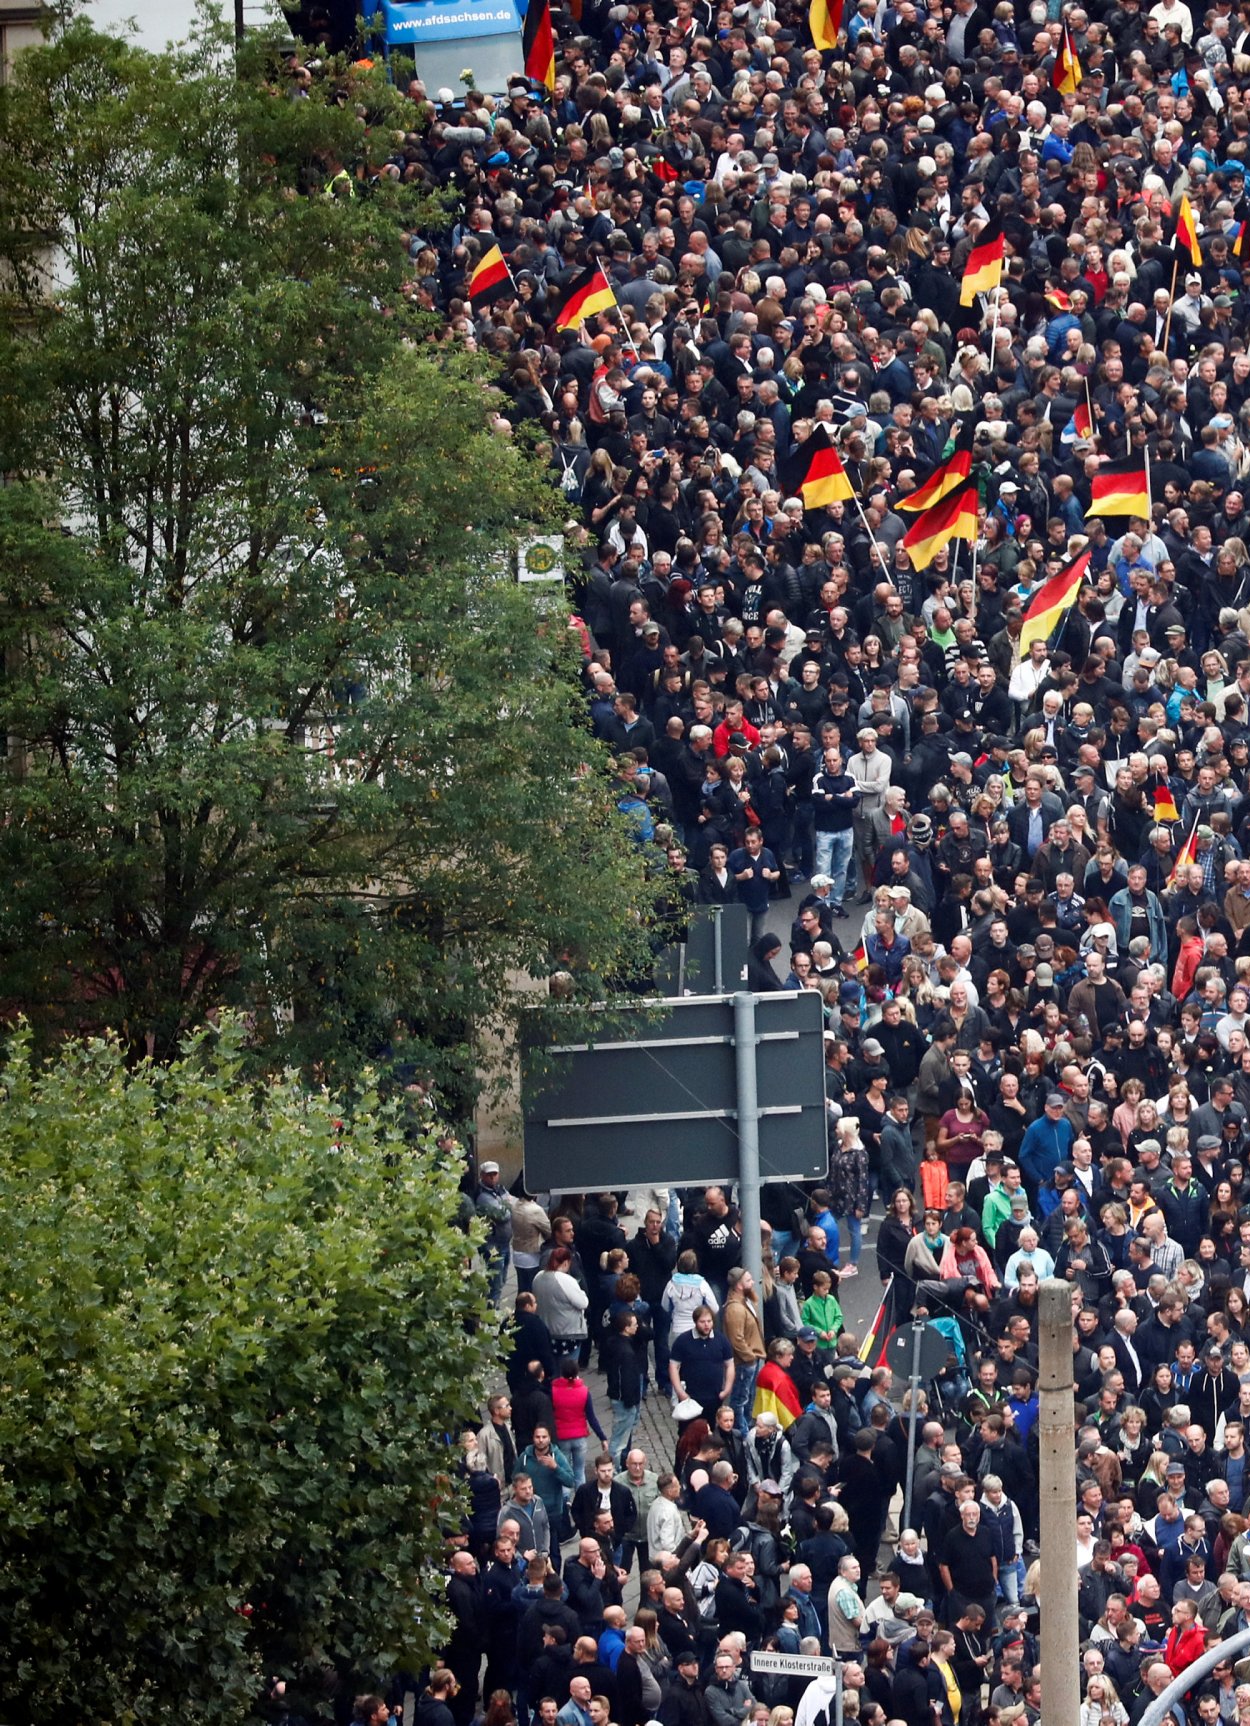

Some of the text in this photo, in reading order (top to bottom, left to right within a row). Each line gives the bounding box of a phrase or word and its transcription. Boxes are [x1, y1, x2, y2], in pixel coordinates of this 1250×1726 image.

[393, 10, 511, 31] www.afdsachsen.de
[708, 1237, 726, 1245] adid
[754, 1657, 831, 1672] Innere Klosterstraße
